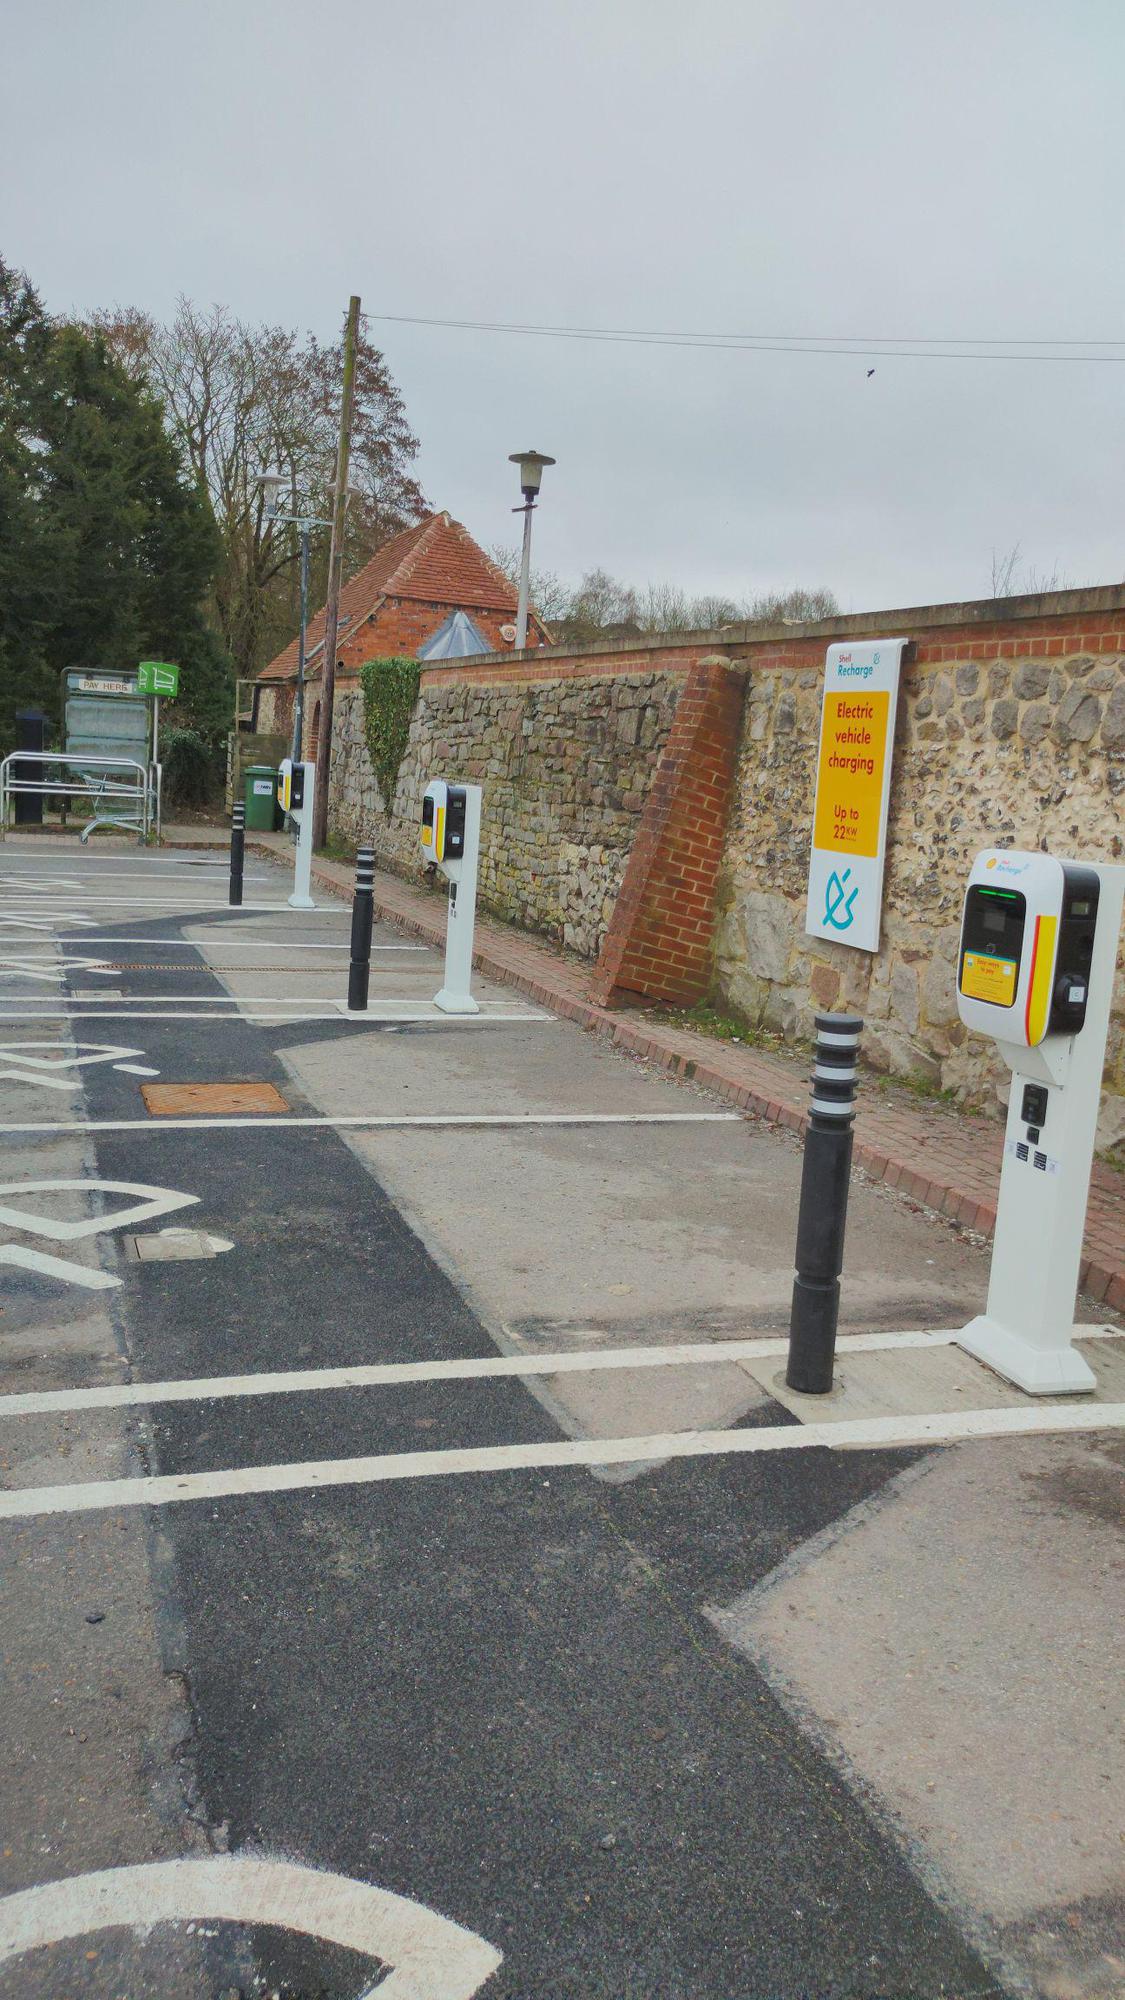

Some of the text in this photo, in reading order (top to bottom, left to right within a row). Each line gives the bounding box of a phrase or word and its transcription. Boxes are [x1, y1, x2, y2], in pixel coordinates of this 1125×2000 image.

[839, 653, 852, 663] Shell
[838, 664, 873, 678] Recharge
[83, 680, 99, 689] PAY
[837, 701, 873, 719] Electric
[835, 726, 871, 744] vehicle
[828, 751, 874, 775] charging
[834, 804, 859, 822] Up to
